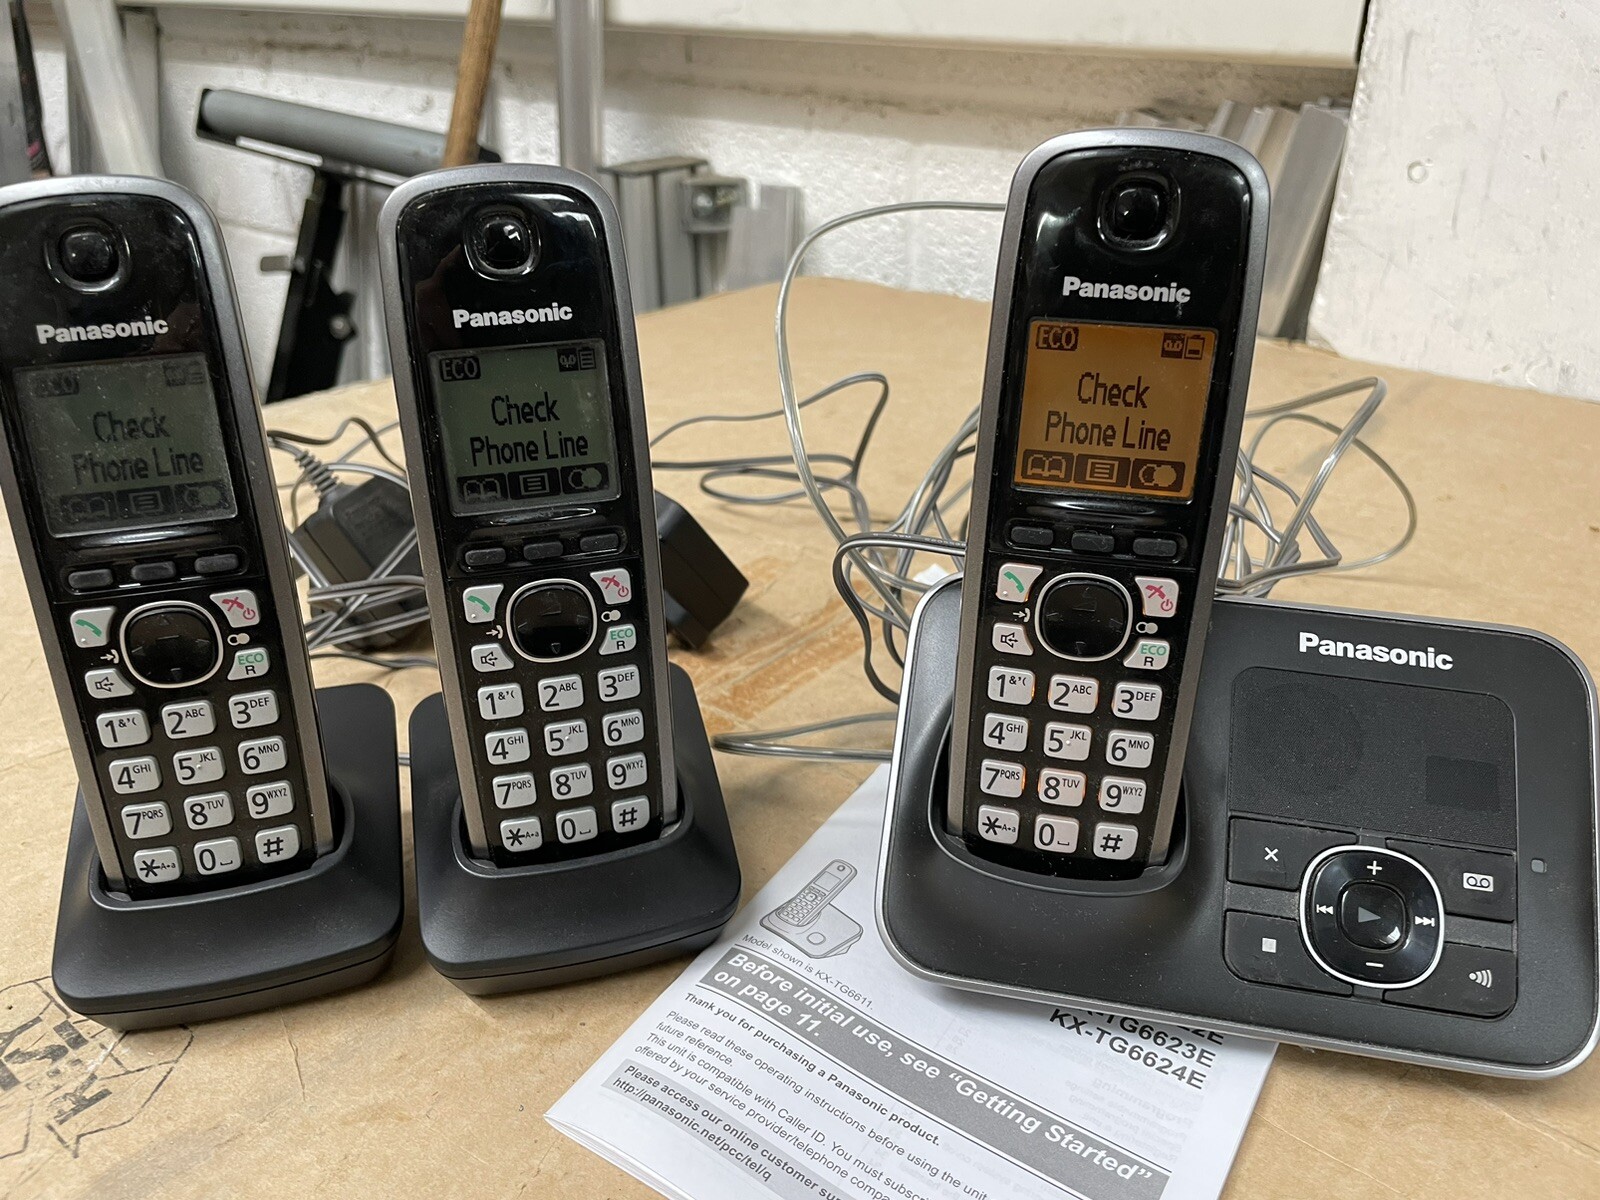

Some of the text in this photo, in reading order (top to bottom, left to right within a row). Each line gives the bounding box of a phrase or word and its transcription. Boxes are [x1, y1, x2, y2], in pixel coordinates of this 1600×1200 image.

[1061, 276, 1192, 304] Panasonic
[35, 316, 169, 345] Panasonic
[452, 302, 573, 329] Panasonic
[1037, 325, 1077, 350] ECO
[440, 357, 480, 381] ECO
[490, 391, 561, 426] Check
[1077, 371, 1151, 409] Check
[92, 408, 171, 443] Check
[1044, 409, 1172, 451] Phone Line
[72, 447, 204, 486] Phone Line
[469, 430, 589, 467] Phone Line
[610, 628, 634, 640] ECO
[616, 640, 626, 650] R
[1140, 643, 1168, 656] ECO
[1298, 631, 1454, 671] Panasonic
[237, 651, 265, 666] ECO
[245, 665, 257, 675] R
[1143, 656, 1155, 667] R
[742, 934, 873, 1011] Model shown is KX-TG6611.
[713, 968, 823, 1038] on page 11.
[656, 1021, 734, 1068] future reference.
[1049, 1008, 1208, 1090] KX-TG6624E
[1086, 1010, 1217, 1068] -TG6623E
[684, 992, 941, 1146] Thank you for purchasing a Panasonic product.
[727, 953, 794, 992] Before
[793, 987, 856, 1028] initial
[852, 1025, 893, 1058] use,
[899, 1051, 942, 1079] see
[949, 1072, 1042, 1134] “Getting
[1044, 1124, 1153, 1180] Started”
[634, 1044, 670, 1065] offered
[669, 1059, 684, 1073] by
[681, 1068, 708, 1087] your
[707, 1082, 747, 1111] service
[745, 1107, 849, 1180] provider/telephone
[645, 1032, 667, 1048] This
[667, 1041, 688, 1058] unit
[686, 1052, 697, 1063] is
[697, 1058, 754, 1097] compatible
[753, 1092, 777, 1113] with
[777, 1107, 811, 1134] Caller
[810, 1129, 827, 1147] ID.
[830, 1141, 853, 1162] You
[853, 1157, 884, 1182] must
[666, 1010, 700, 1031] Please
[700, 1024, 726, 1044] read
[724, 1038, 754, 1062] these
[754, 1057, 804, 1095] operating
[804, 1088, 867, 1134] instructions
[867, 1128, 906, 1156] before
[906, 1152, 940, 1178] using
[940, 1170, 962, 1188] the
[963, 1184, 989, 1200] unit
[612, 1077, 773, 1183] http://panasonic.net/pcc/tel/q
[624, 1065, 661, 1088] Please
[660, 1083, 700, 1112] access
[701, 1108, 723, 1125] our
[722, 1122, 760, 1150] online
[760, 1148, 819, 1190] customer
